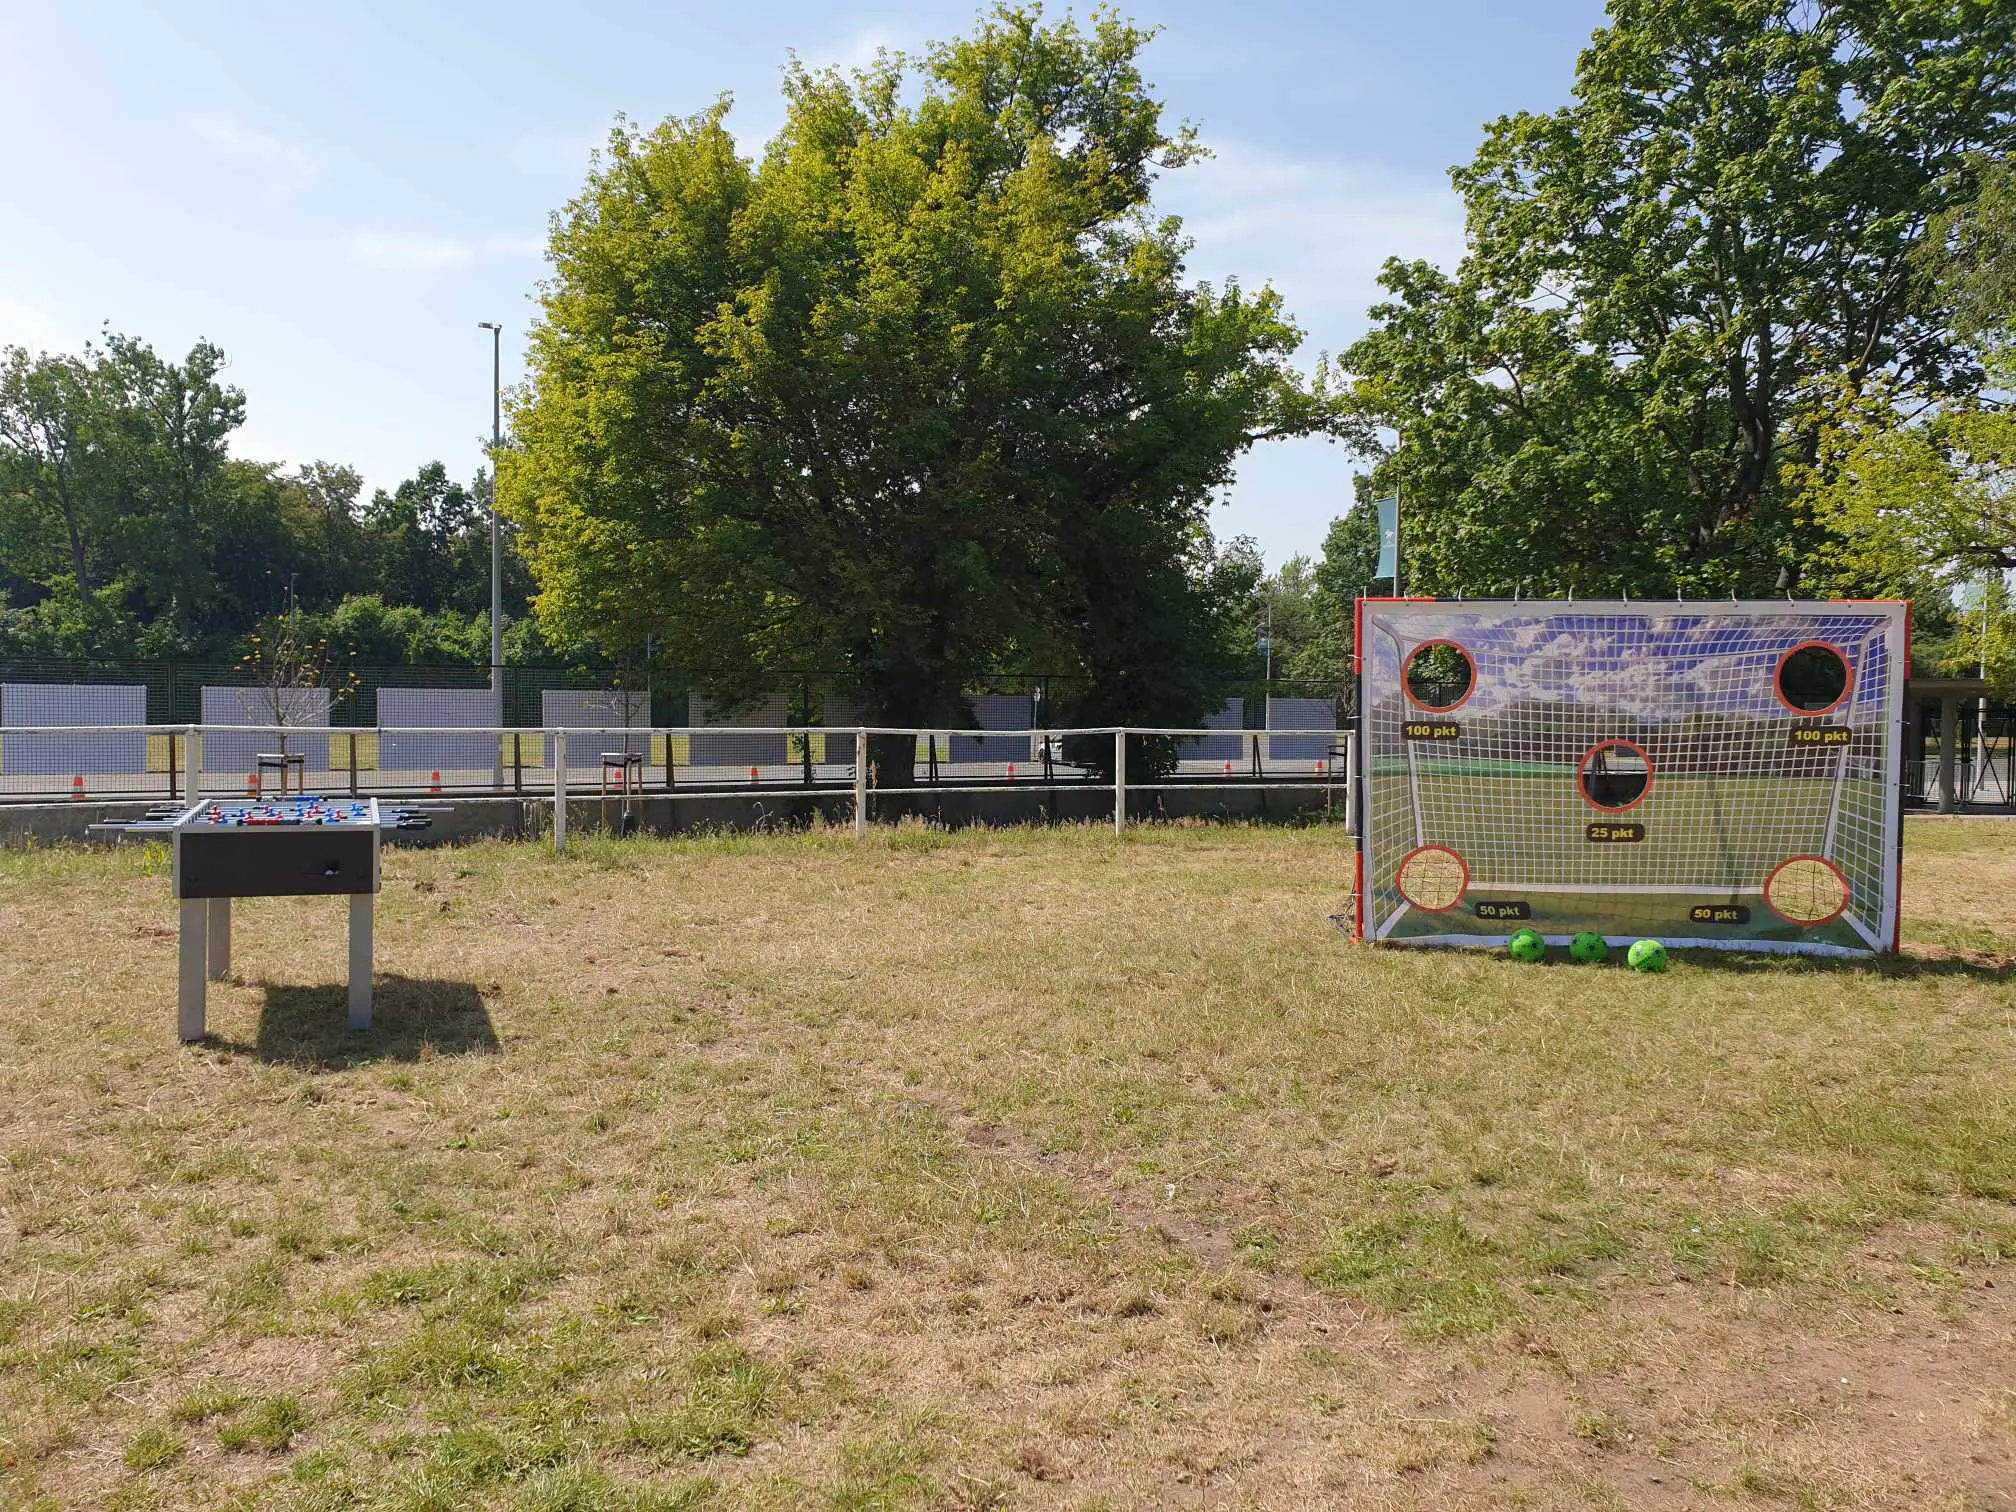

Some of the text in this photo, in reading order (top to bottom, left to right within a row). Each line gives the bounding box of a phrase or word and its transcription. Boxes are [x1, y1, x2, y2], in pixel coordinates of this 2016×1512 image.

[1405, 725, 1457, 739] 100 pkt
[1794, 730, 1848, 744] 100 pkt
[1590, 827, 1634, 841] 25 pkt
[1479, 905, 1520, 918] 50 pkt
[1694, 908, 1738, 922] 50 pkt
